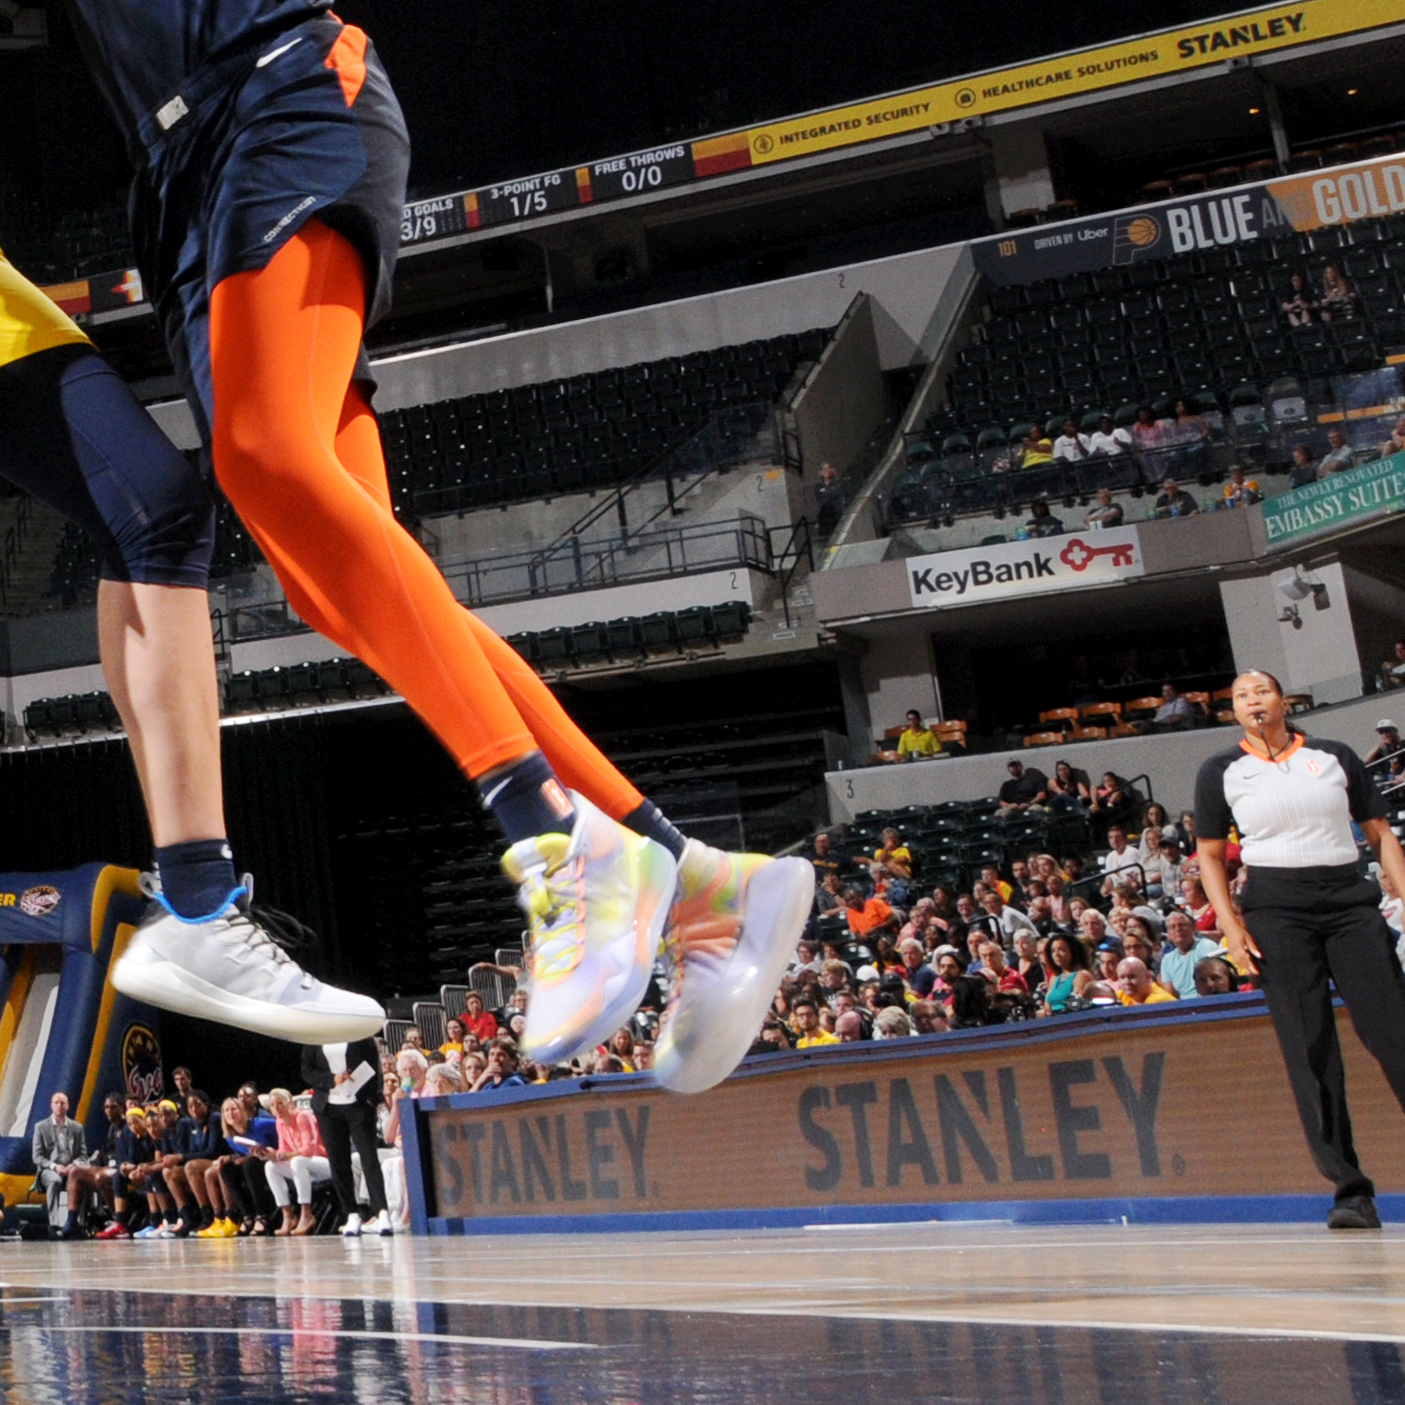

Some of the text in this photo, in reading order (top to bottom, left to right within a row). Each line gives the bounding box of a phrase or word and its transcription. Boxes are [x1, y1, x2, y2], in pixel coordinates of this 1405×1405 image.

[779, 12, 1304, 146] INTEGRATED SECURITY HEALTHCARE SOLUTIONS STANLEY
[595, 146, 685, 176] FREE THROWS
[491, 173, 561, 200] 3-POINT FG
[622, 166, 662, 192] 0/0
[413, 198, 454, 218] GOALS
[510, 191, 548, 217] 1/5
[998, 240, 1017, 256] 101
[1034, 235, 1062, 250] DRIVEN
[1063, 232, 1074, 244] BY
[1078, 227, 1108, 241] Uber
[1166, 194, 1258, 254] BLUE
[1312, 165, 1405, 225] GOLD
[400, 216, 436, 242] 3/9
[1277, 459, 1394, 509] THE NEWLY RENOVATED
[1264, 494, 1344, 539] EMBASSY
[730, 571, 739, 590] 2
[912, 552, 1055, 595] KeyBank
[845, 779, 854, 799] 3
[799, 1052, 1165, 1192] STANLEY
[438, 1105, 649, 1204] STANLEY
